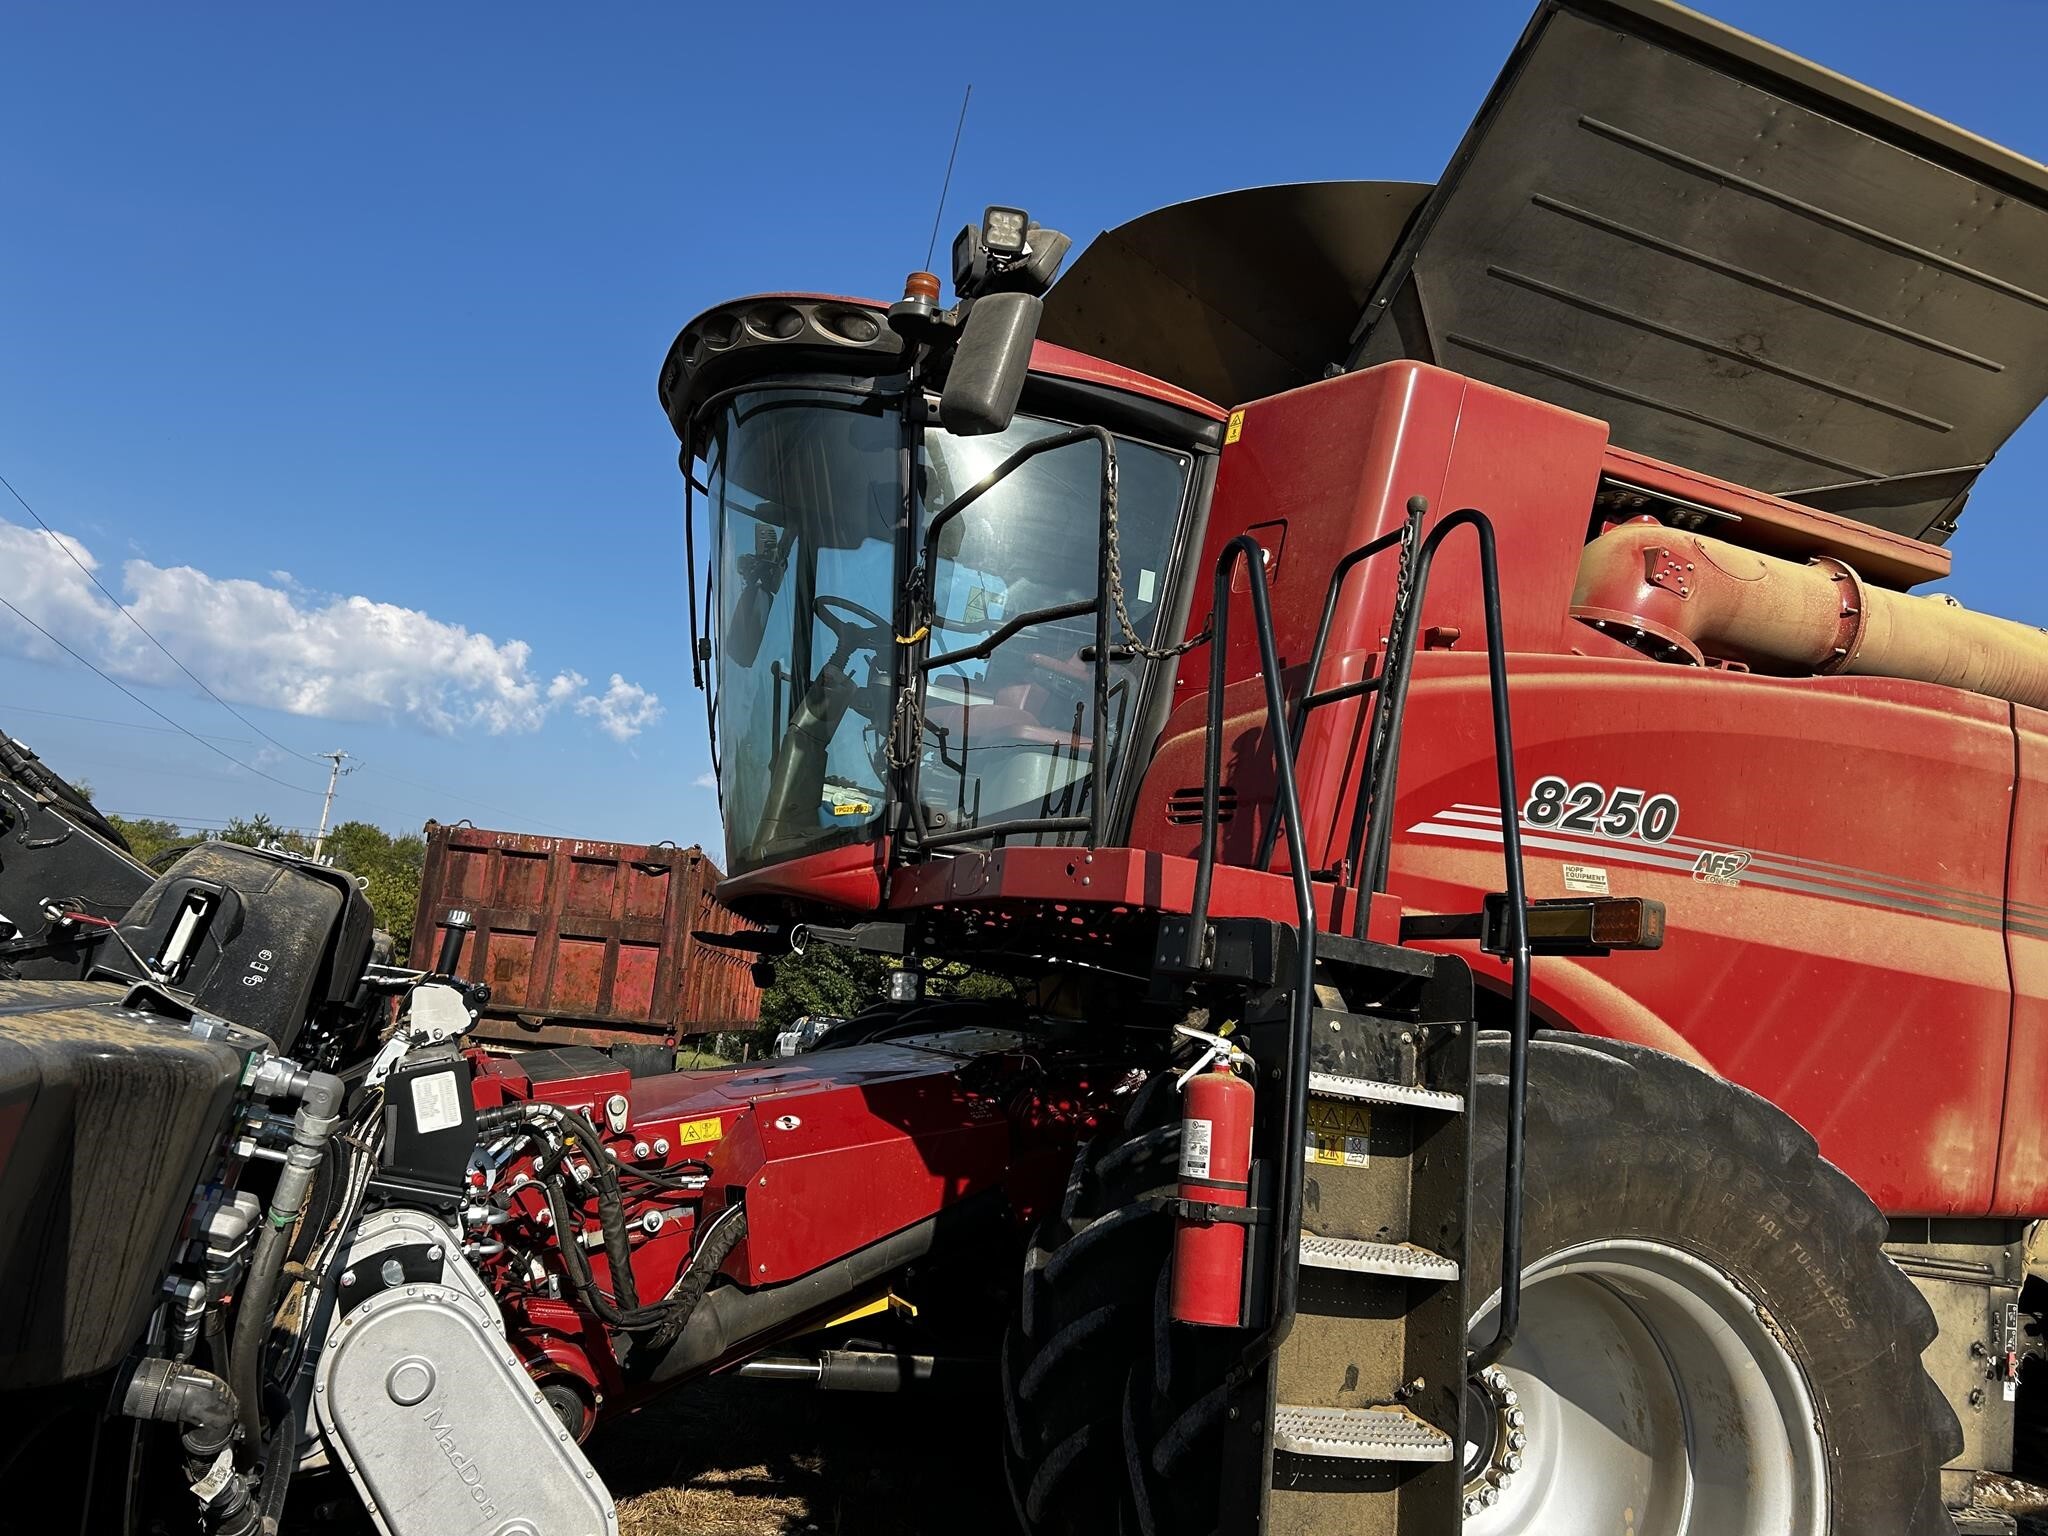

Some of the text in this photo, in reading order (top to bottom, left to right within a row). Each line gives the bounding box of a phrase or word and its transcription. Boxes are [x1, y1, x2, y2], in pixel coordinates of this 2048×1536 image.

[1524, 776, 1679, 844] 8250
[1565, 871, 1605, 881] EQUIPMENT
[1693, 850, 1739, 878] AFS
[423, 1406, 498, 1520] MacDon
